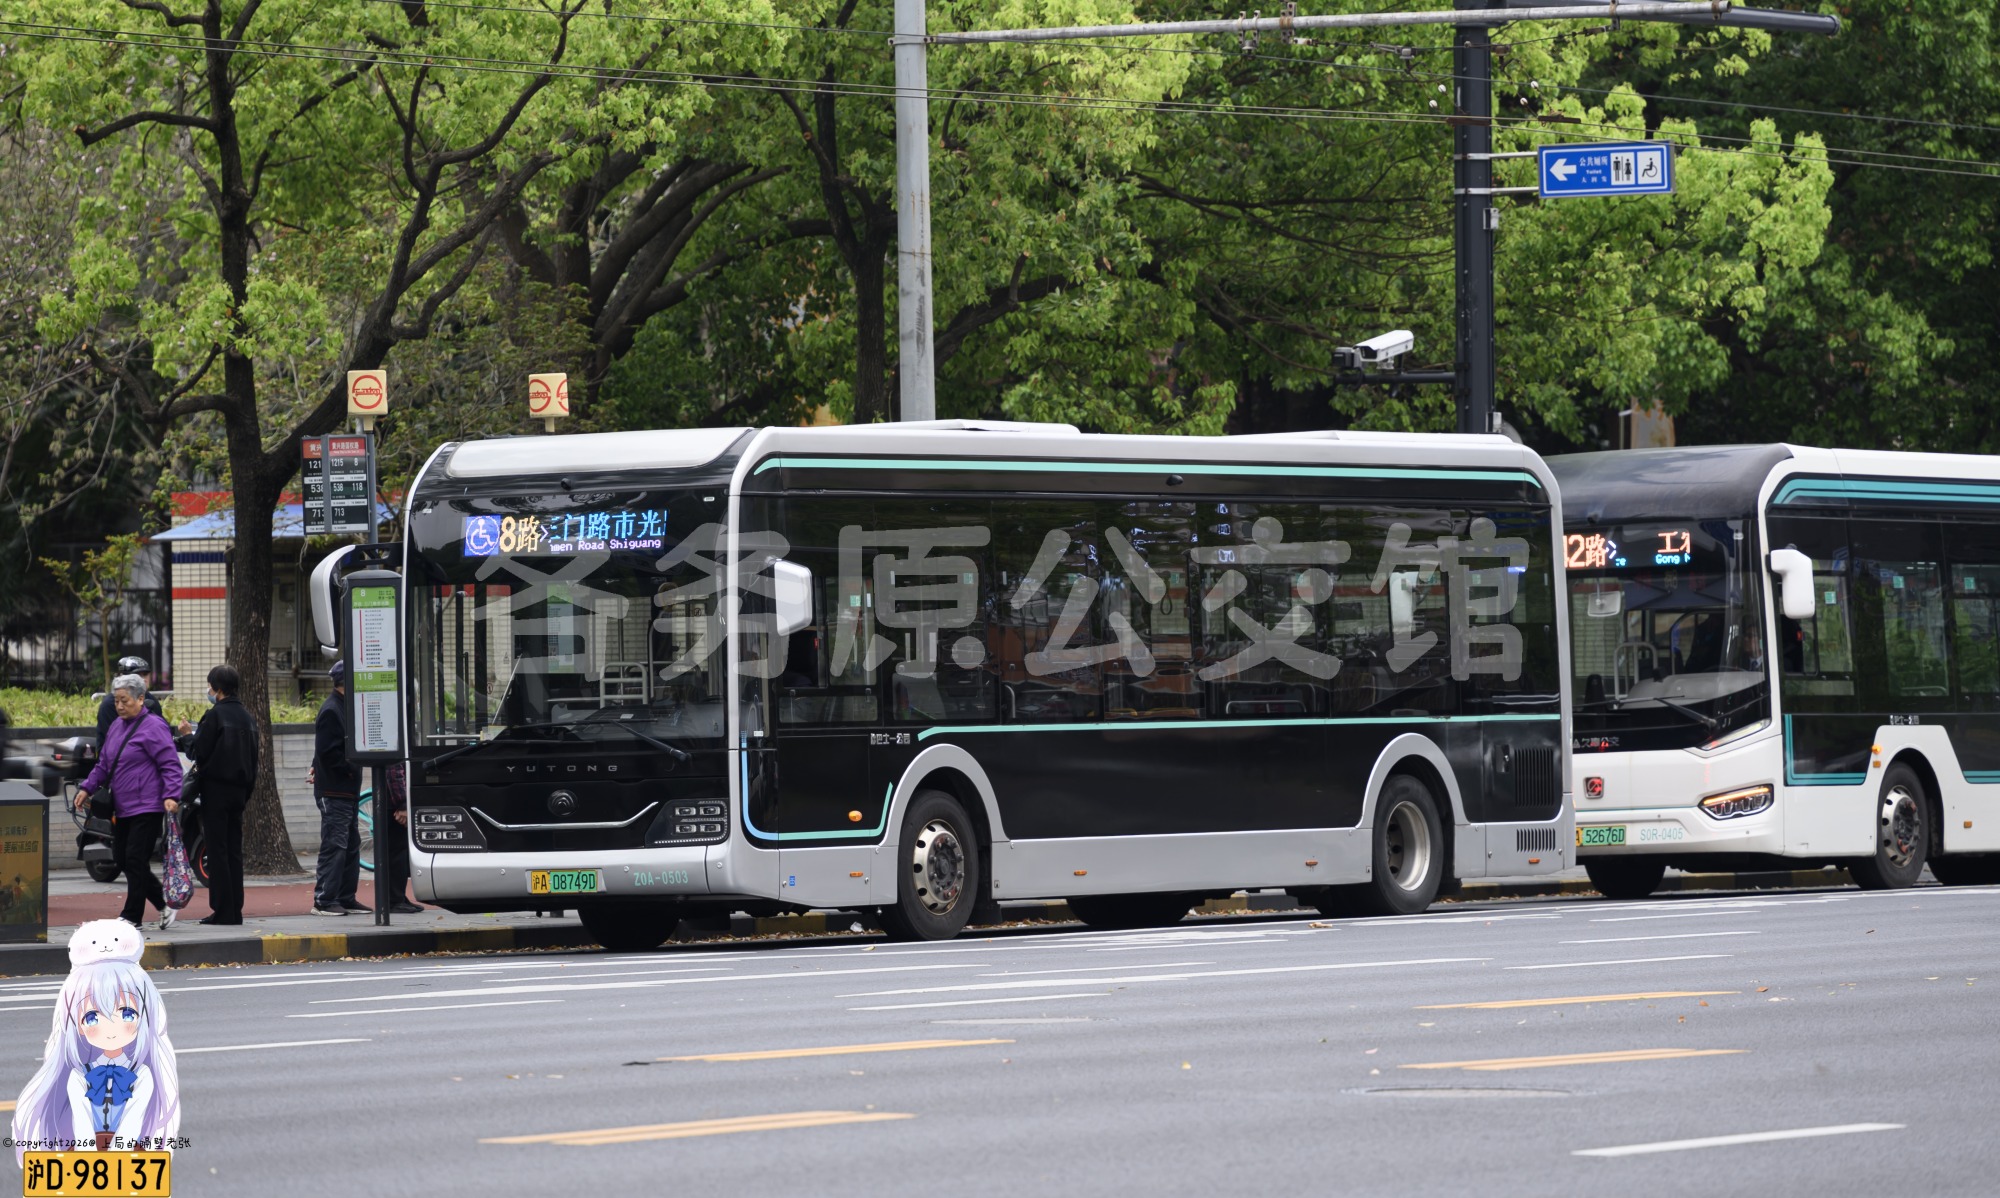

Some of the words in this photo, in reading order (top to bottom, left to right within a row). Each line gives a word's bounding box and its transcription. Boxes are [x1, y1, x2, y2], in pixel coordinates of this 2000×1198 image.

[1579, 156, 1608, 167] 公共厕所
[308, 460, 322, 469] 121
[331, 458, 344, 467] 1215
[333, 483, 344, 492] 538
[352, 482, 363, 491] 118
[334, 508, 345, 517] 713
[549, 509, 667, 543] 门路市光
[500, 515, 541, 553] 8路
[578, 541, 604, 551] Road
[609, 538, 661, 550] Shiguang
[1655, 554, 1680, 565] Gong
[360, 589, 366, 597] 8
[358, 672, 373, 681] 118
[506, 765, 619, 773] YUTONG
